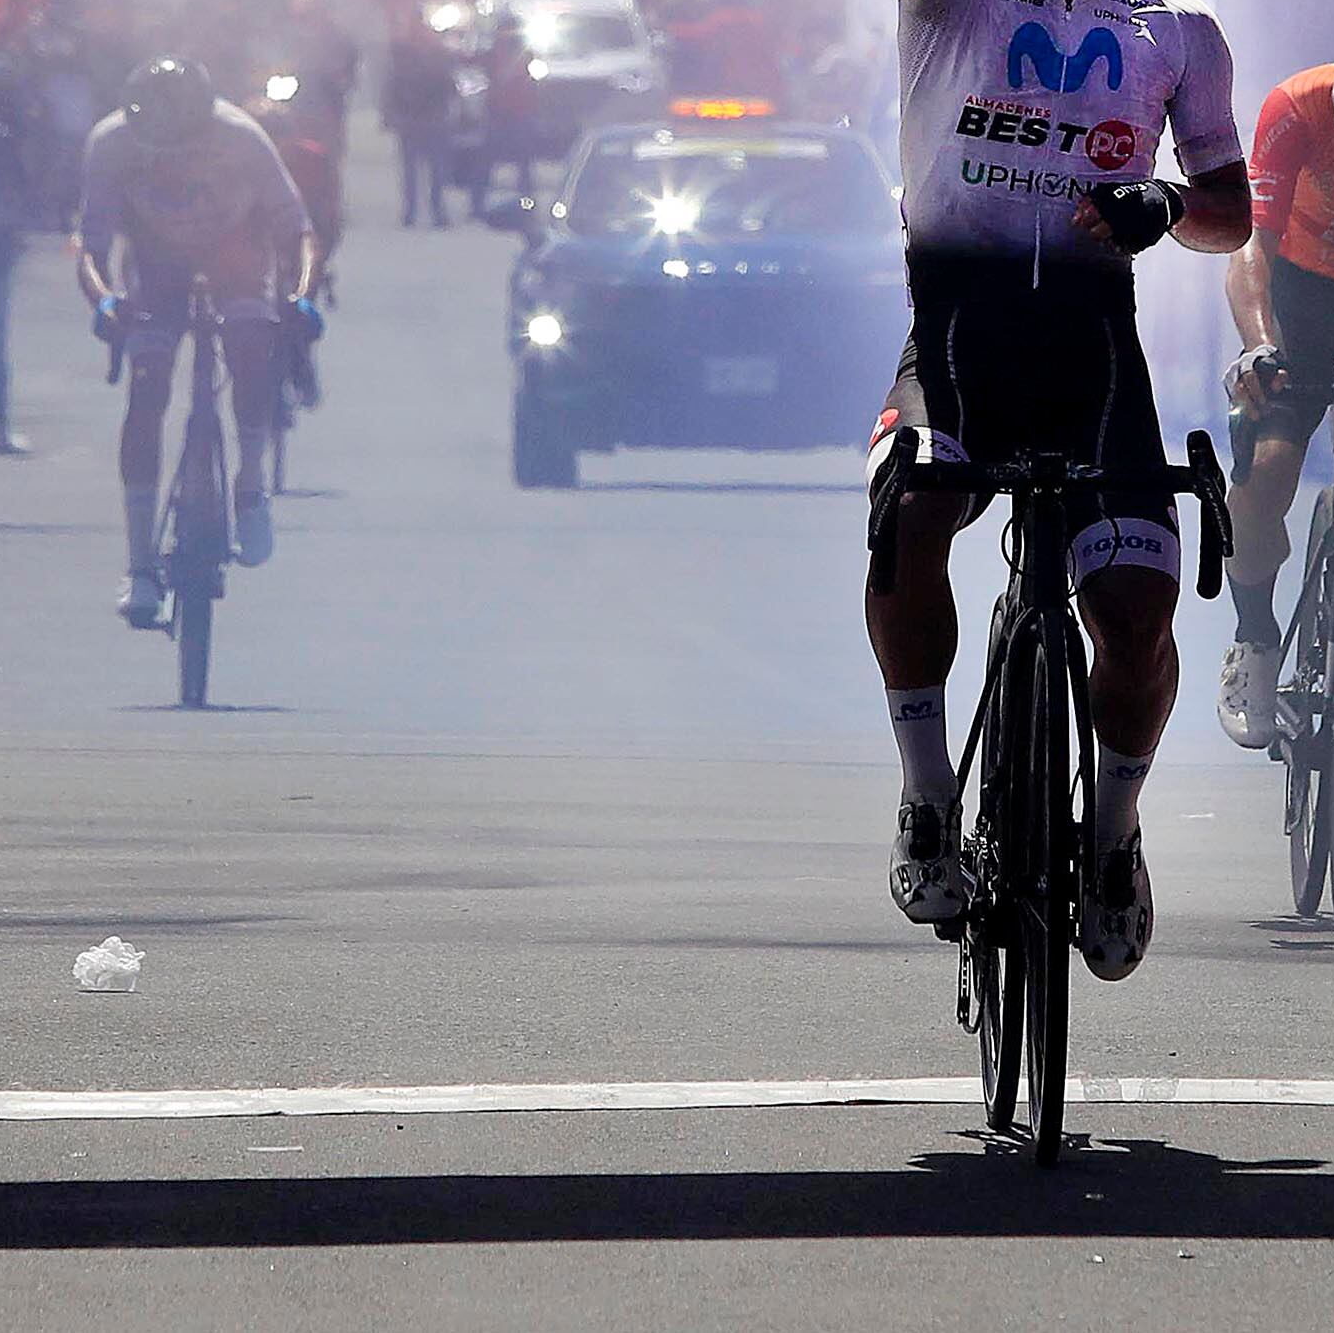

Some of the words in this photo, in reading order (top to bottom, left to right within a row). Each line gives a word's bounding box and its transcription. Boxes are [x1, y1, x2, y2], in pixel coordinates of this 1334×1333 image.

[956, 105, 1089, 154] BEST
[1090, 131, 1133, 158] PC
[962, 159, 1095, 201] UPHON
